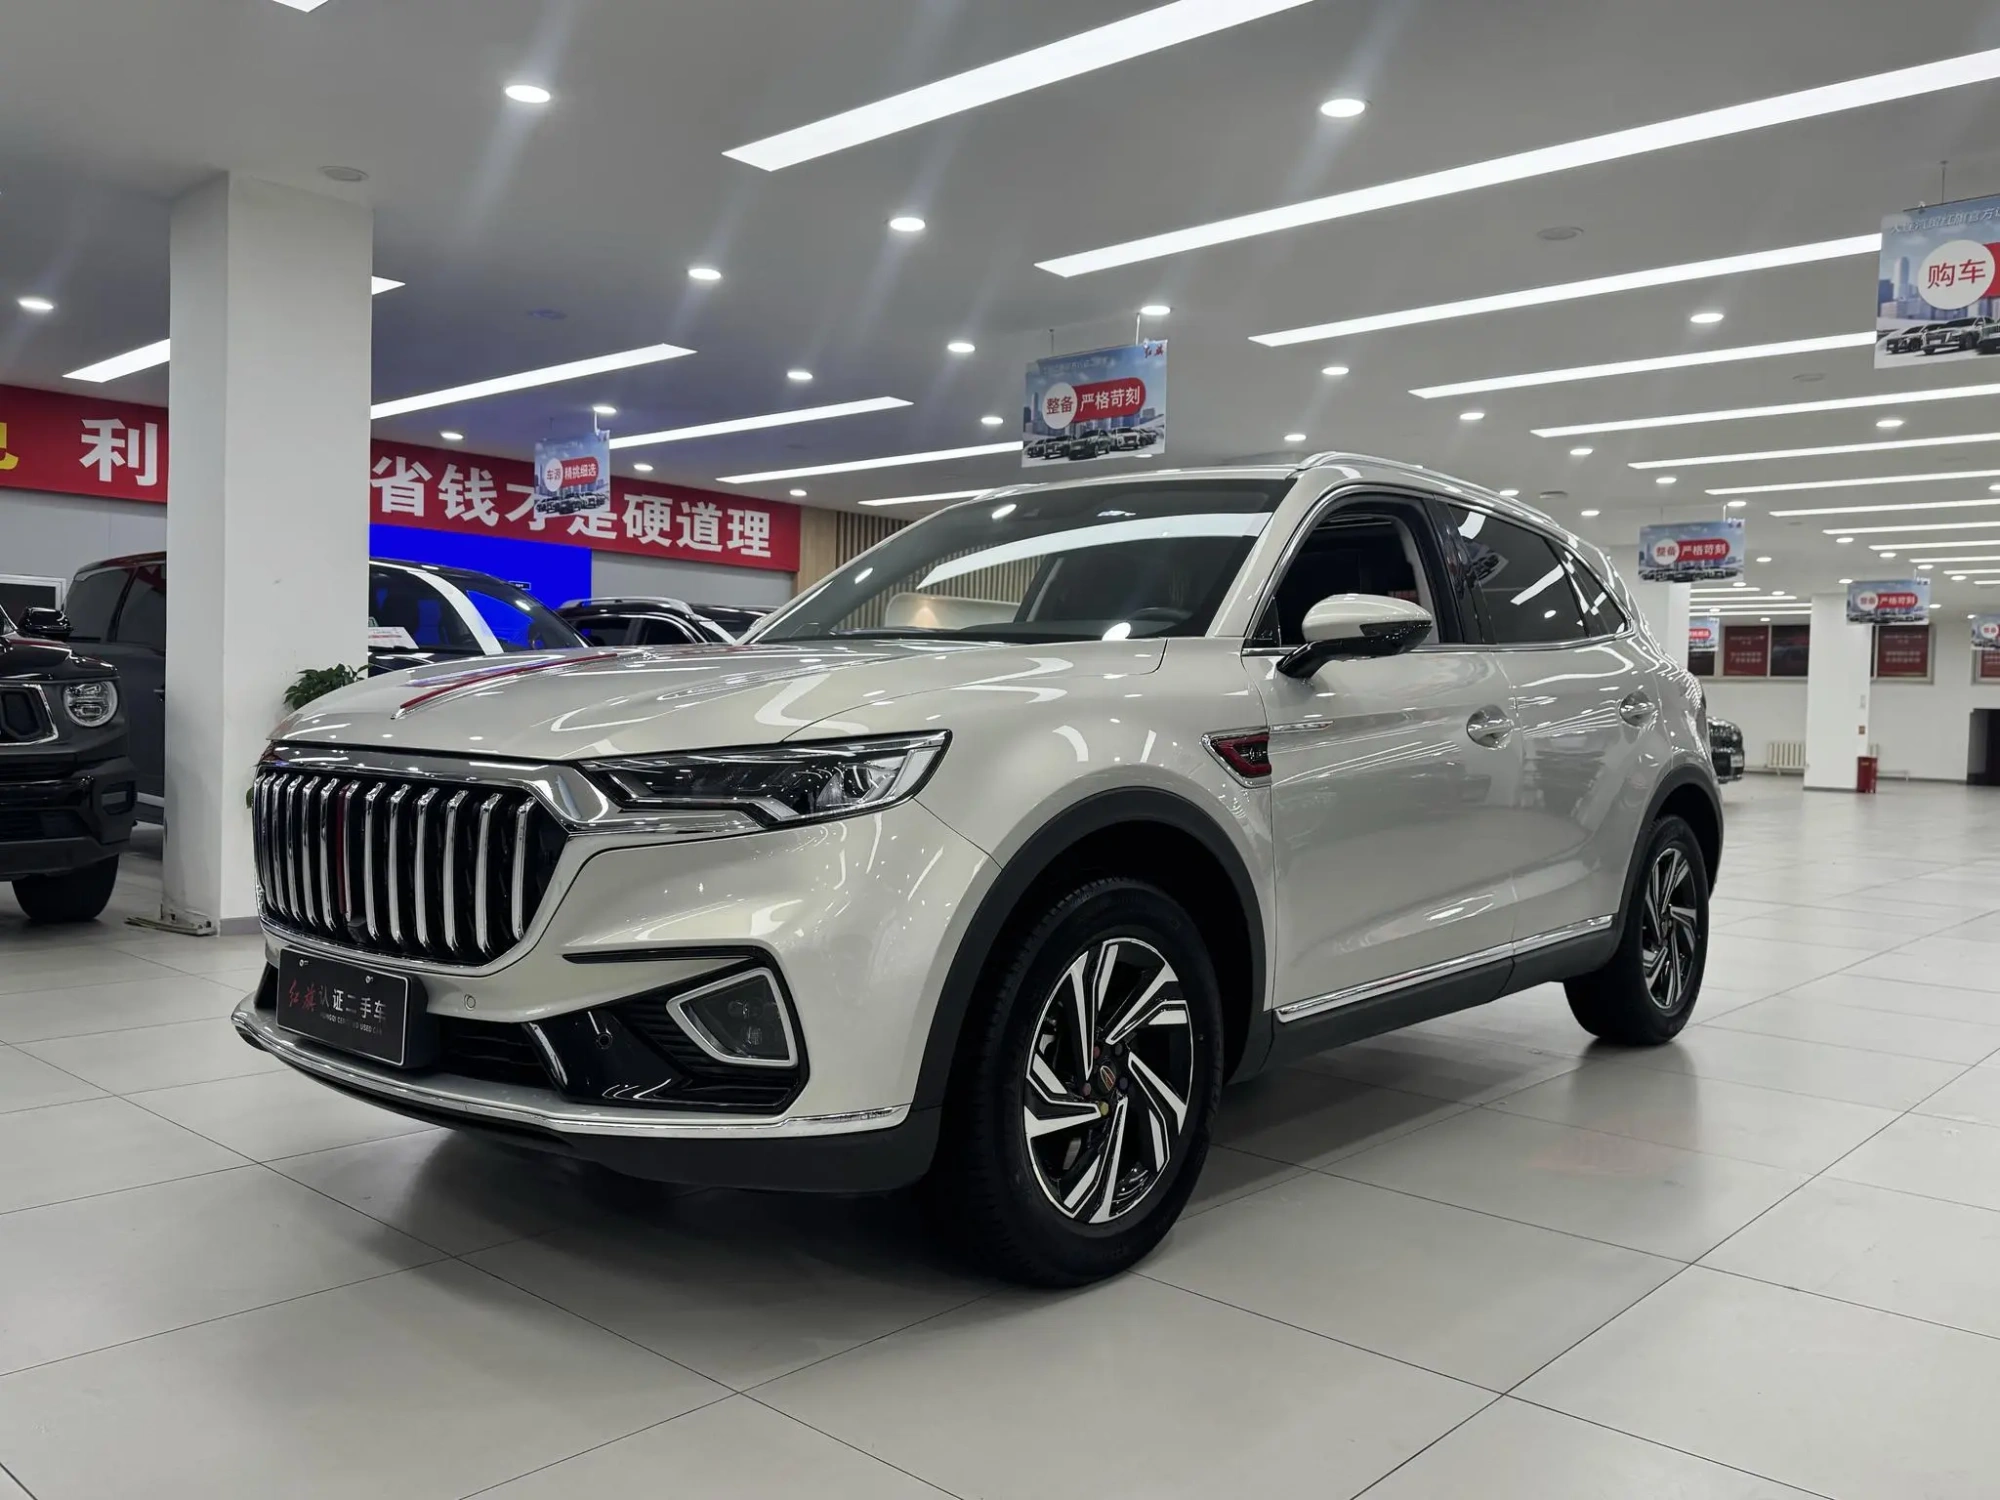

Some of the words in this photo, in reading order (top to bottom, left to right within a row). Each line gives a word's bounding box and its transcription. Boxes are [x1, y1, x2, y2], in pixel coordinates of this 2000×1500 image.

[1928, 259, 1986, 289] 购车
[1046, 396, 1073, 415] 整备
[1080, 386, 1140, 412] 严格苛刻
[79, 418, 158, 486] 利
[1681, 543, 1727, 557] 严格苛刻
